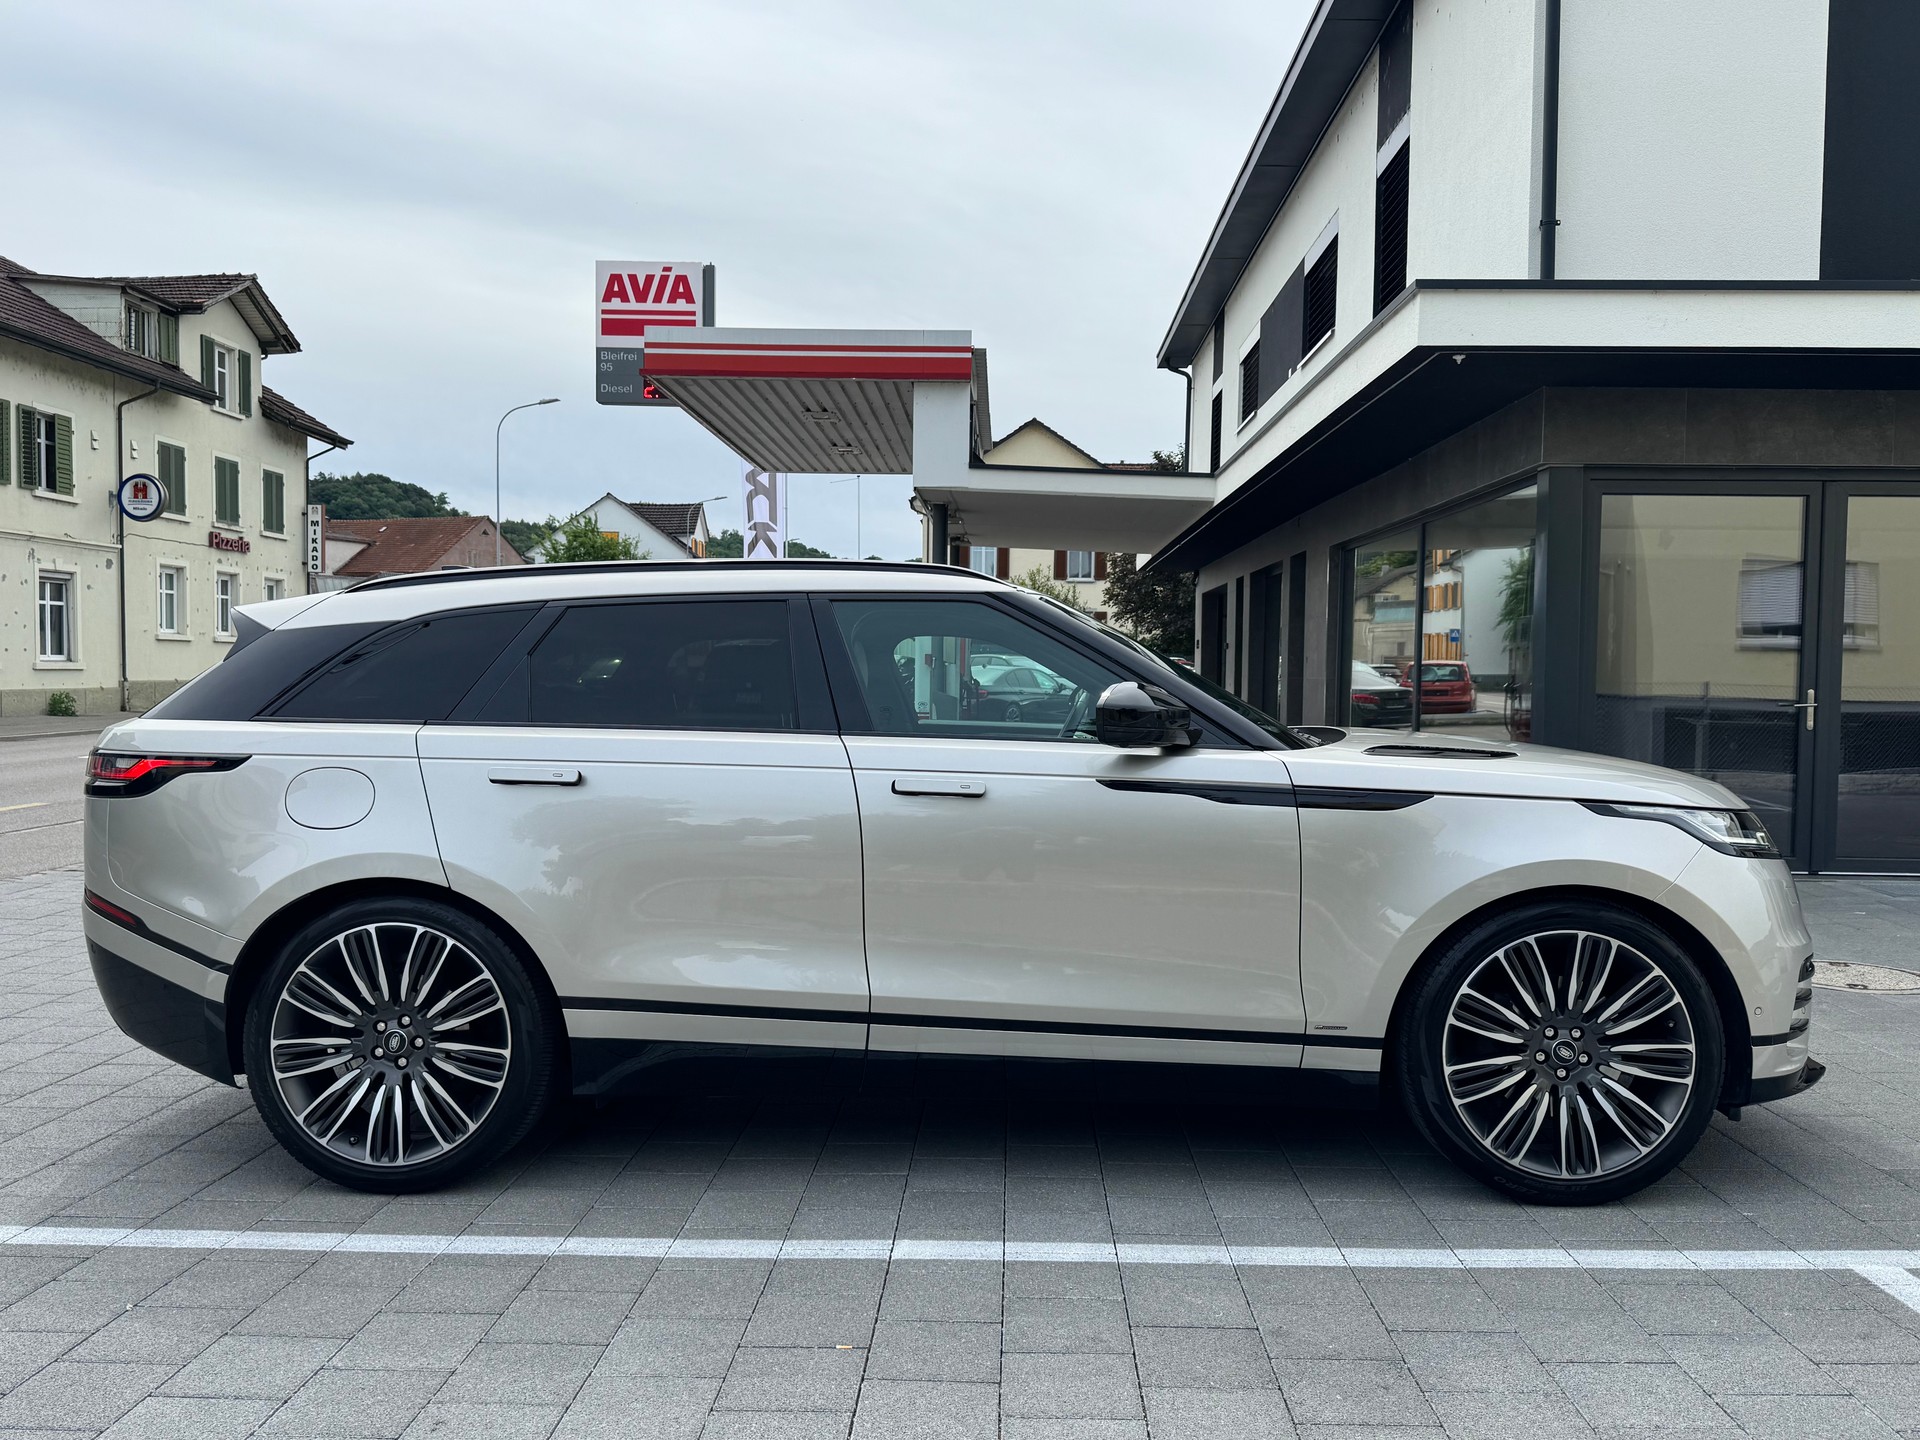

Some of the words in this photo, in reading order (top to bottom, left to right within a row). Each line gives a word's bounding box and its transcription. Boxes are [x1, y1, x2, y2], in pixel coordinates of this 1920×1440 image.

[600, 351, 638, 361] Bleifrei
[600, 362, 613, 372] 95
[600, 383, 633, 393] Diesel
[212, 532, 251, 553] Pizzeria
[310, 520, 320, 570] MIKADO
